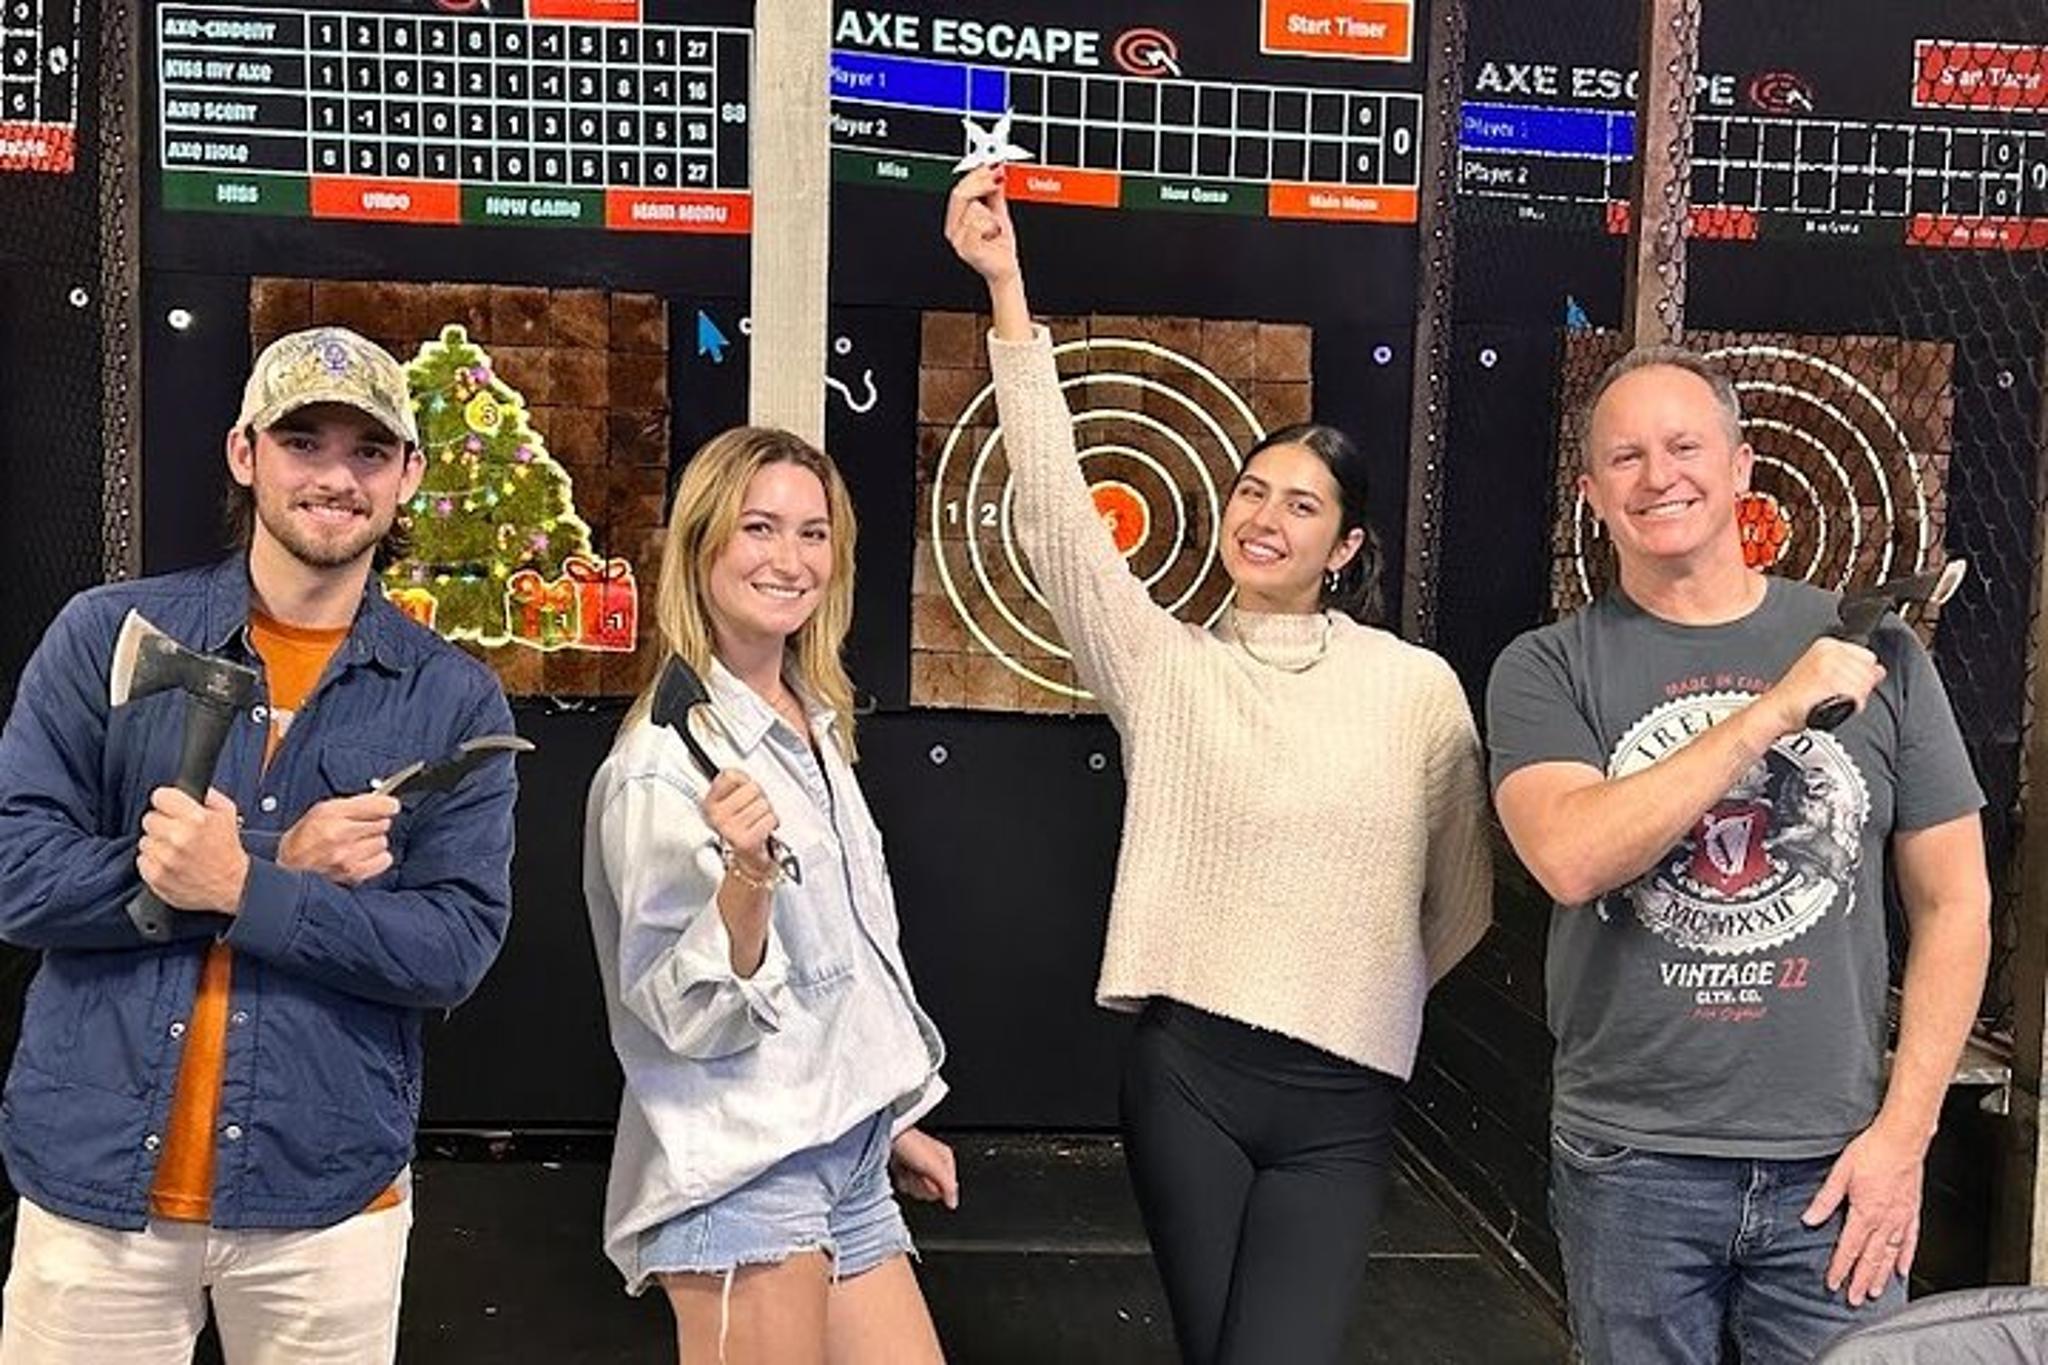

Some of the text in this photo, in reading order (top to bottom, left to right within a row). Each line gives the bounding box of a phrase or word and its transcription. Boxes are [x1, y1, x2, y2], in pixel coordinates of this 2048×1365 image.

[1287, 14, 1387, 38] Start Timer
[321, 25, 331, 43] 1
[358, 25, 370, 44] 2
[432, 29, 445, 48] 2
[505, 33, 519, 51] 0
[541, 34, 558, 52] -1
[580, 36, 593, 54] 5
[619, 37, 628, 55] 1
[656, 39, 665, 57] 1
[688, 40, 708, 58] 27
[836, 9, 1100, 66] AXE ESCAPE
[165, 59, 203, 79] KISS
[322, 65, 331, 85] 1
[359, 67, 369, 86] 1
[395, 70, 409, 88] 0
[432, 70, 445, 89] 2
[470, 73, 483, 91] 2
[508, 74, 518, 92] 1
[542, 76, 558, 95] -1
[580, 76, 592, 95] 3
[653, 81, 667, 98] -1
[688, 82, 706, 100] 16
[879, 72, 886, 88] 1
[1475, 61, 1558, 95] AXE
[323, 108, 333, 126] 1
[358, 110, 373, 127] -1
[394, 111, 410, 128] -1
[433, 113, 447, 130] 0
[471, 114, 483, 132] 2
[509, 116, 518, 134] 1
[545, 116, 557, 134] 3
[581, 119, 594, 136] 0
[656, 121, 666, 139] 5
[1359, 107, 1371, 124] 0
[876, 118, 888, 137] 2
[1393, 127, 1410, 155] 0
[1358, 155, 1369, 172] 0
[1999, 144, 2009, 161] 0
[360, 150, 373, 168] 3
[397, 152, 410, 170] 0
[435, 154, 445, 171] 1
[472, 155, 482, 174] 1
[508, 157, 521, 175] 0
[582, 159, 594, 177] 5
[619, 161, 629, 179] 1
[654, 162, 667, 179] 0
[688, 163, 708, 181] 27
[877, 161, 909, 178] Miss
[1518, 167, 1528, 183] 2
[2032, 162, 2048, 189] 0
[217, 183, 259, 203] MISS
[1997, 189, 2007, 205] 0
[946, 503, 958, 524] 1
[981, 504, 997, 526] 2
[1660, 957, 1810, 988] VINTAGE 22
